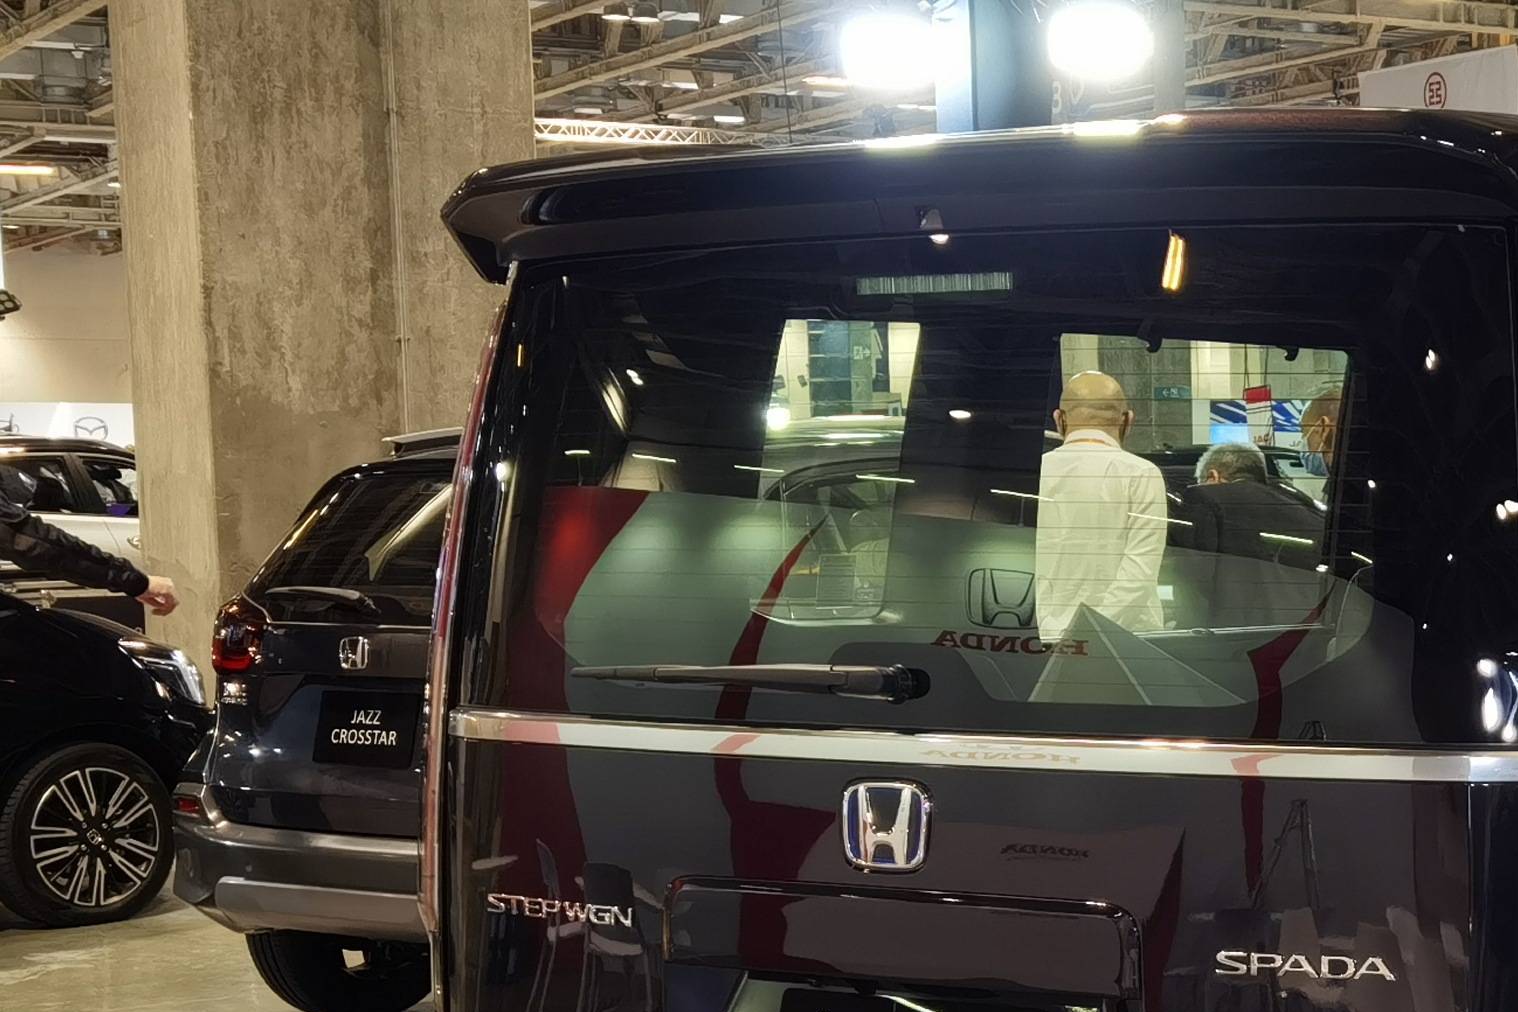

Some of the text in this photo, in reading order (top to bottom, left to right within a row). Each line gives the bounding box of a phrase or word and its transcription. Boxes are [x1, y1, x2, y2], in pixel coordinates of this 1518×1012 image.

[350, 709, 382, 725] JAZZ
[330, 728, 397, 746] CROSSTAR
[1215, 950, 1397, 982] SPADA
